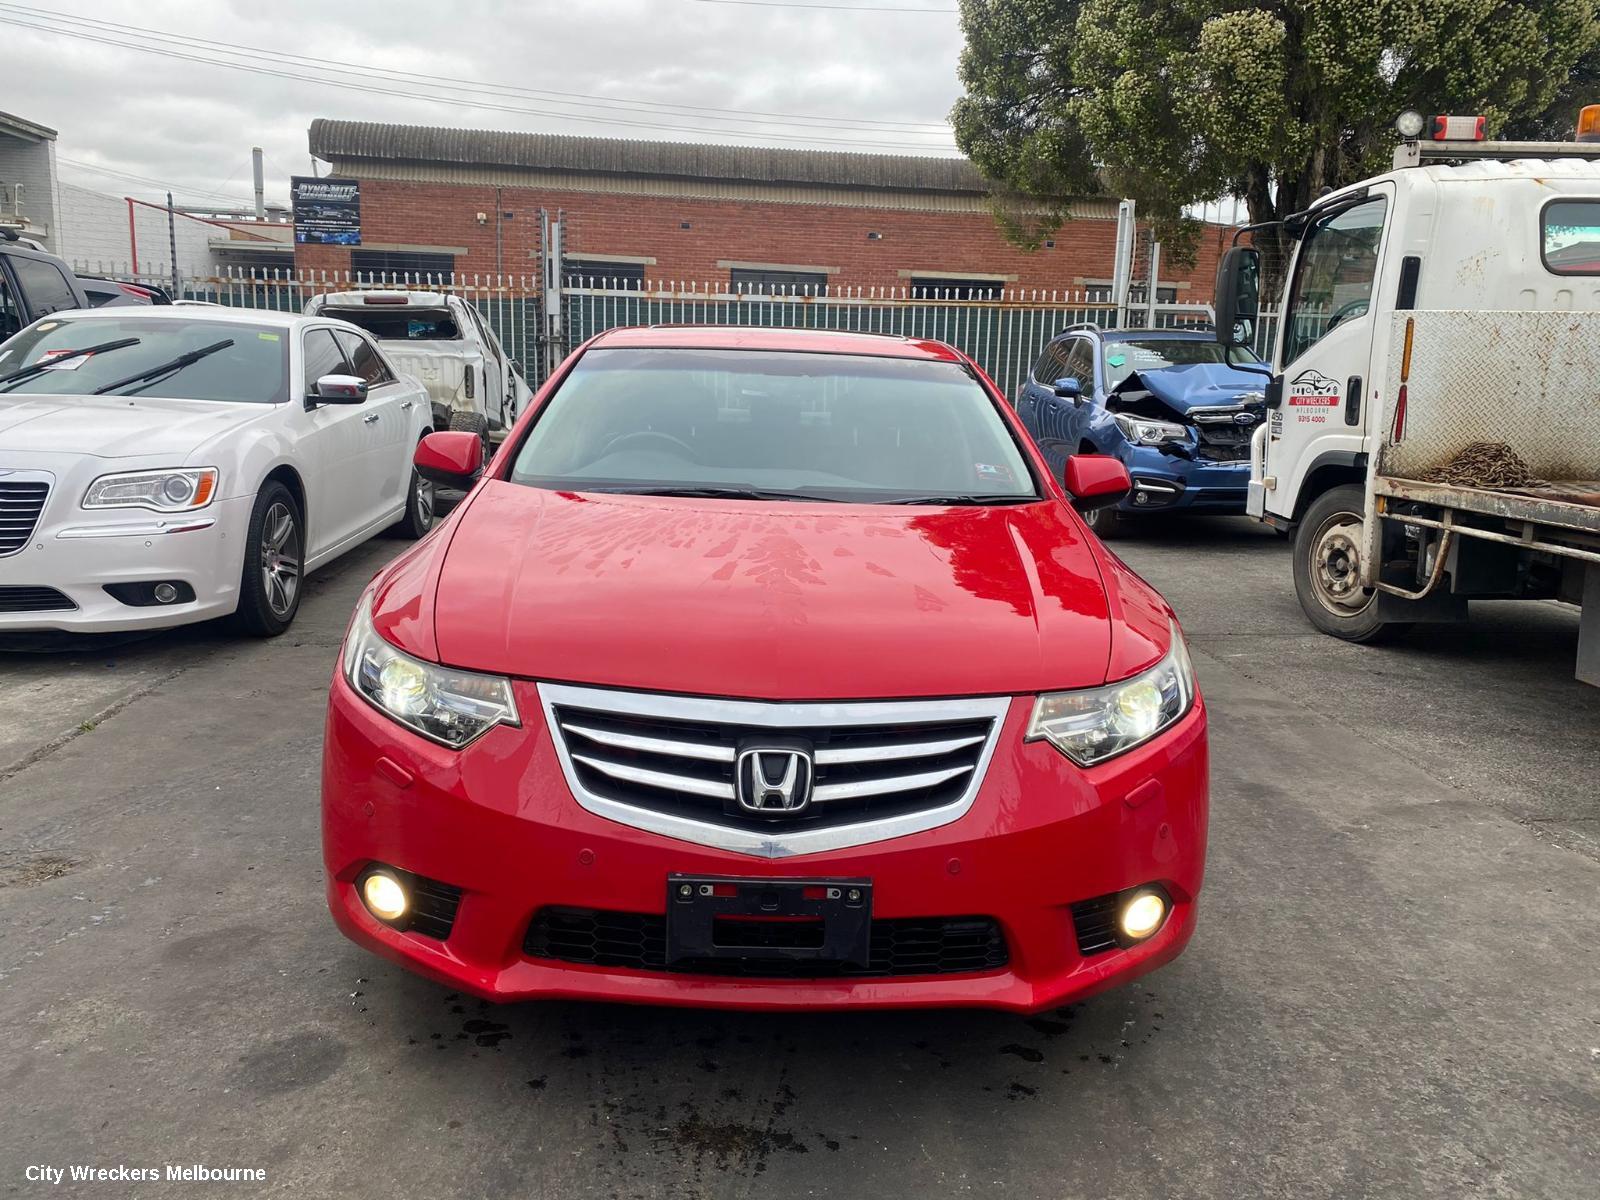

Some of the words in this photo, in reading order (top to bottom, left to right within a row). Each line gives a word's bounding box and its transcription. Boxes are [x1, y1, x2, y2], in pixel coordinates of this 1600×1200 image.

[299, 183, 357, 196] DYNO-MITE
[300, 193, 351, 201] PERFORMANCE
[1296, 397, 1305, 405] CITY
[1306, 397, 1331, 405] WRECKERS
[1311, 415, 1326, 423] 4000
